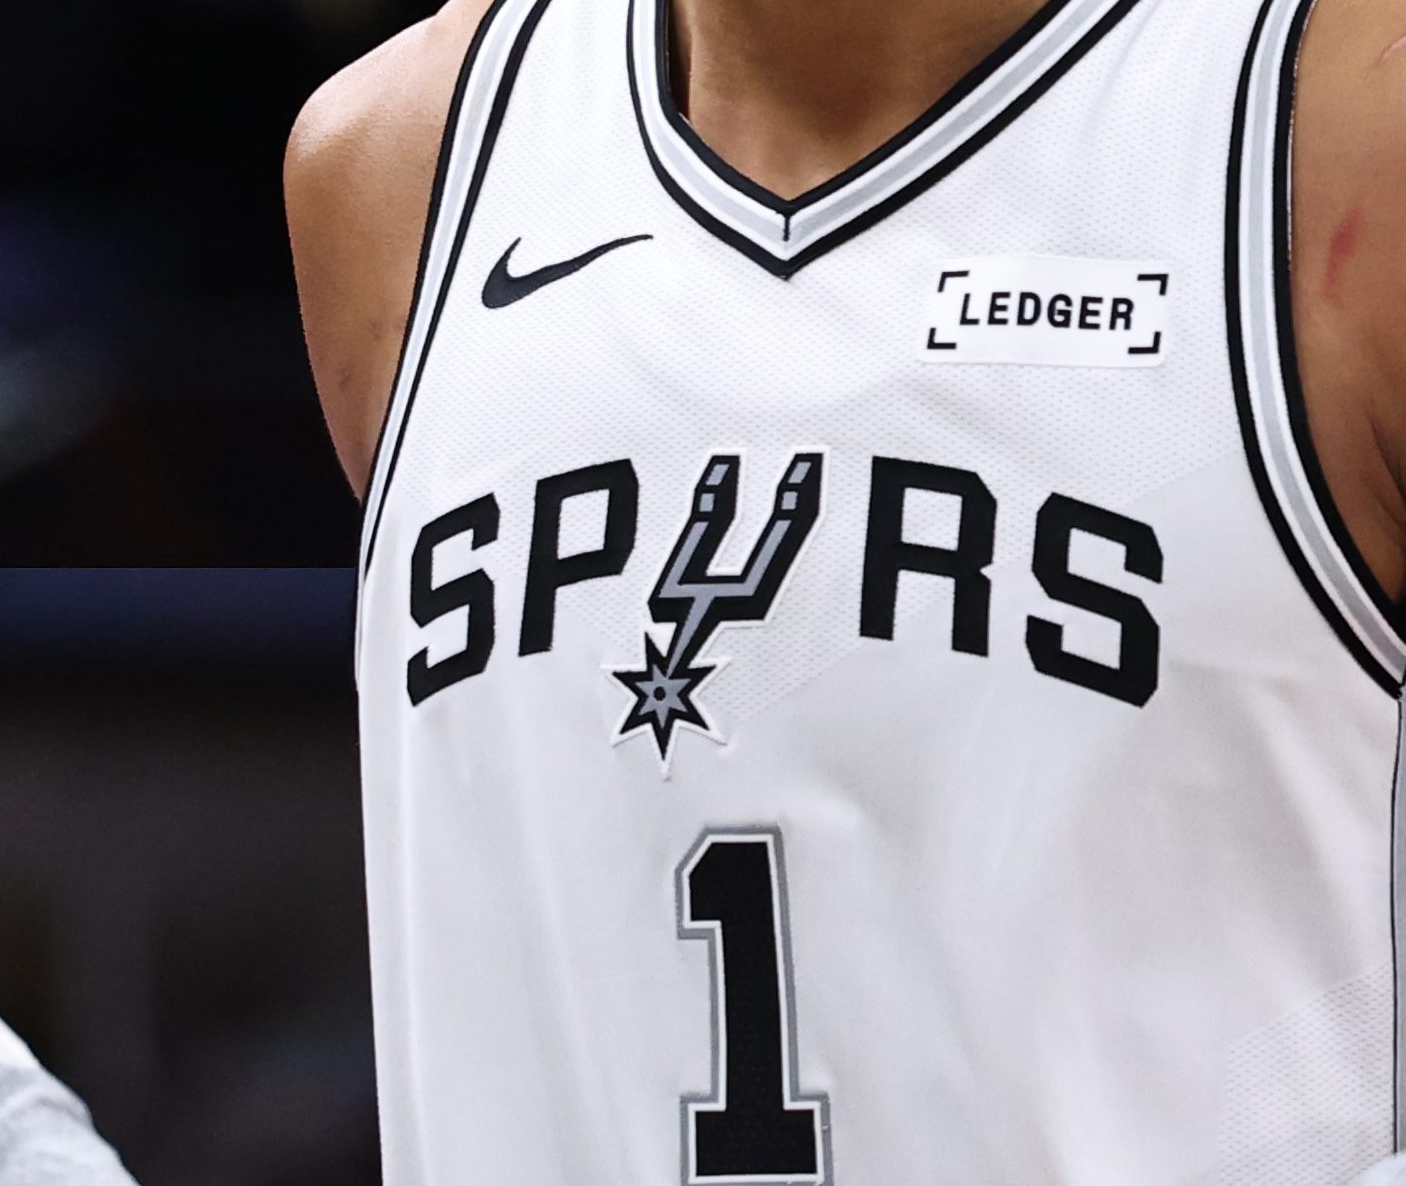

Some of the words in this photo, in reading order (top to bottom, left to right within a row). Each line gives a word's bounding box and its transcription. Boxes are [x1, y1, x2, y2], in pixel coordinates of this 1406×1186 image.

[958, 290, 1135, 331] LEDGER
[406, 452, 1165, 764] SPURS
[674, 822, 834, 1186] 1
